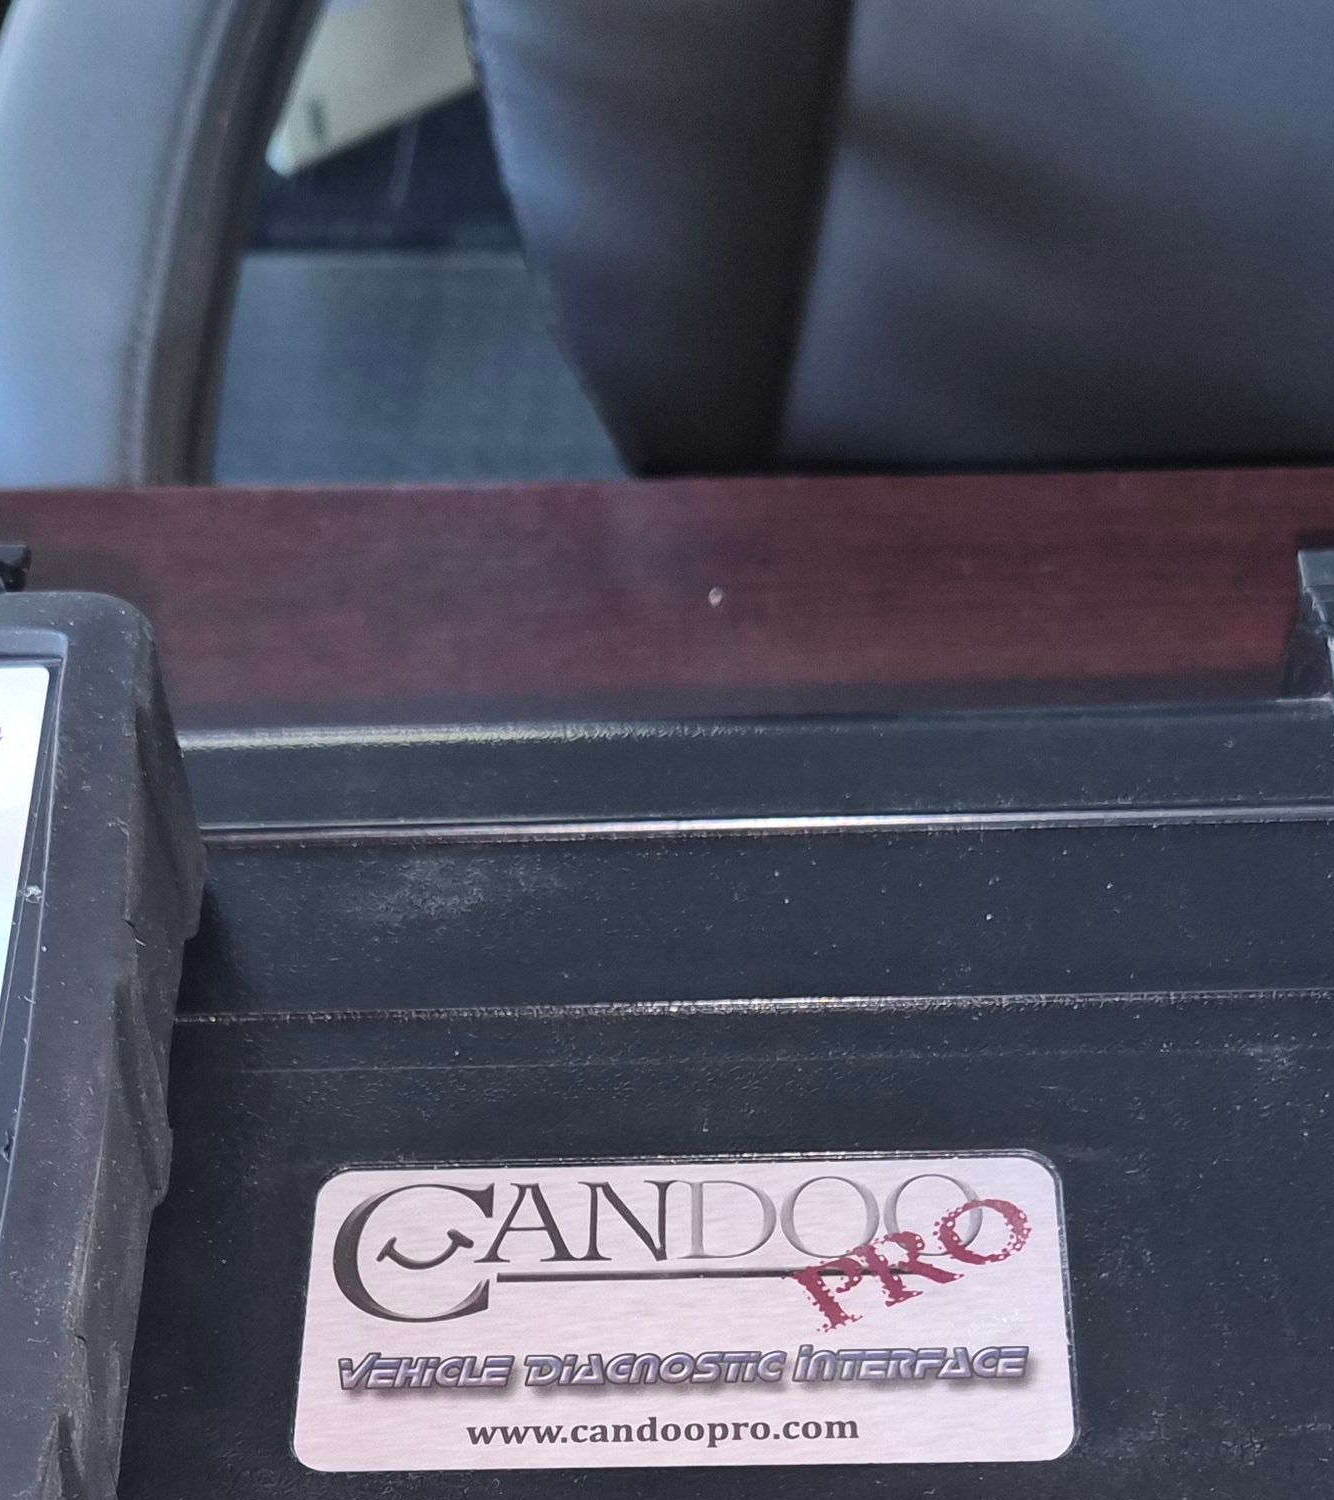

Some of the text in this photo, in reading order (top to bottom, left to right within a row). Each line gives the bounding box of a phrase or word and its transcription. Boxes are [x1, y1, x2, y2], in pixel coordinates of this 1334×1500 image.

[333, 1174, 1032, 1332] CANDOO PRO
[467, 1417, 860, 1449] www.candoopro.com
